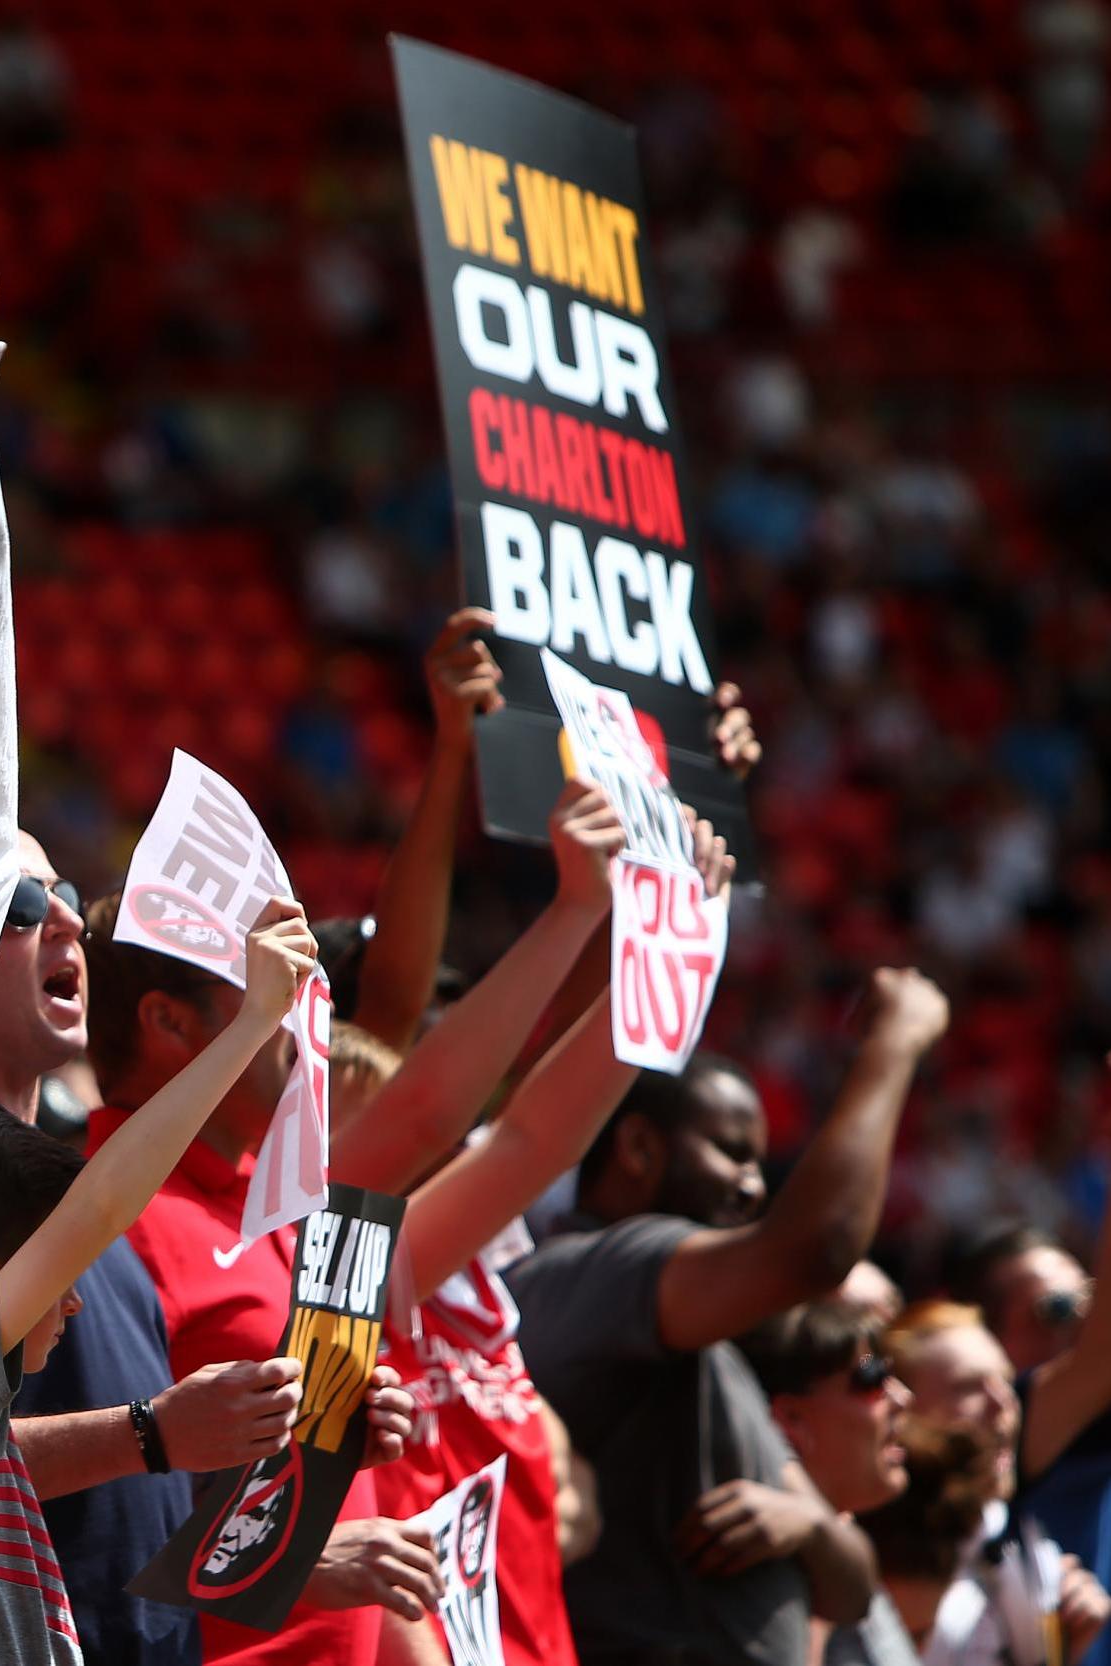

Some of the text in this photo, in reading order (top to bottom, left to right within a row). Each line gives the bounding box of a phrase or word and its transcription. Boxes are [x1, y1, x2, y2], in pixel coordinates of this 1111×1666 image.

[429, 133, 646, 316] WE WANT
[452, 262, 668, 435] OUR
[467, 386, 686, 549] CHARLTON
[480, 500, 715, 696] BACK
[621, 937, 714, 1052] OUT
[349, 1220, 391, 1315] UP
